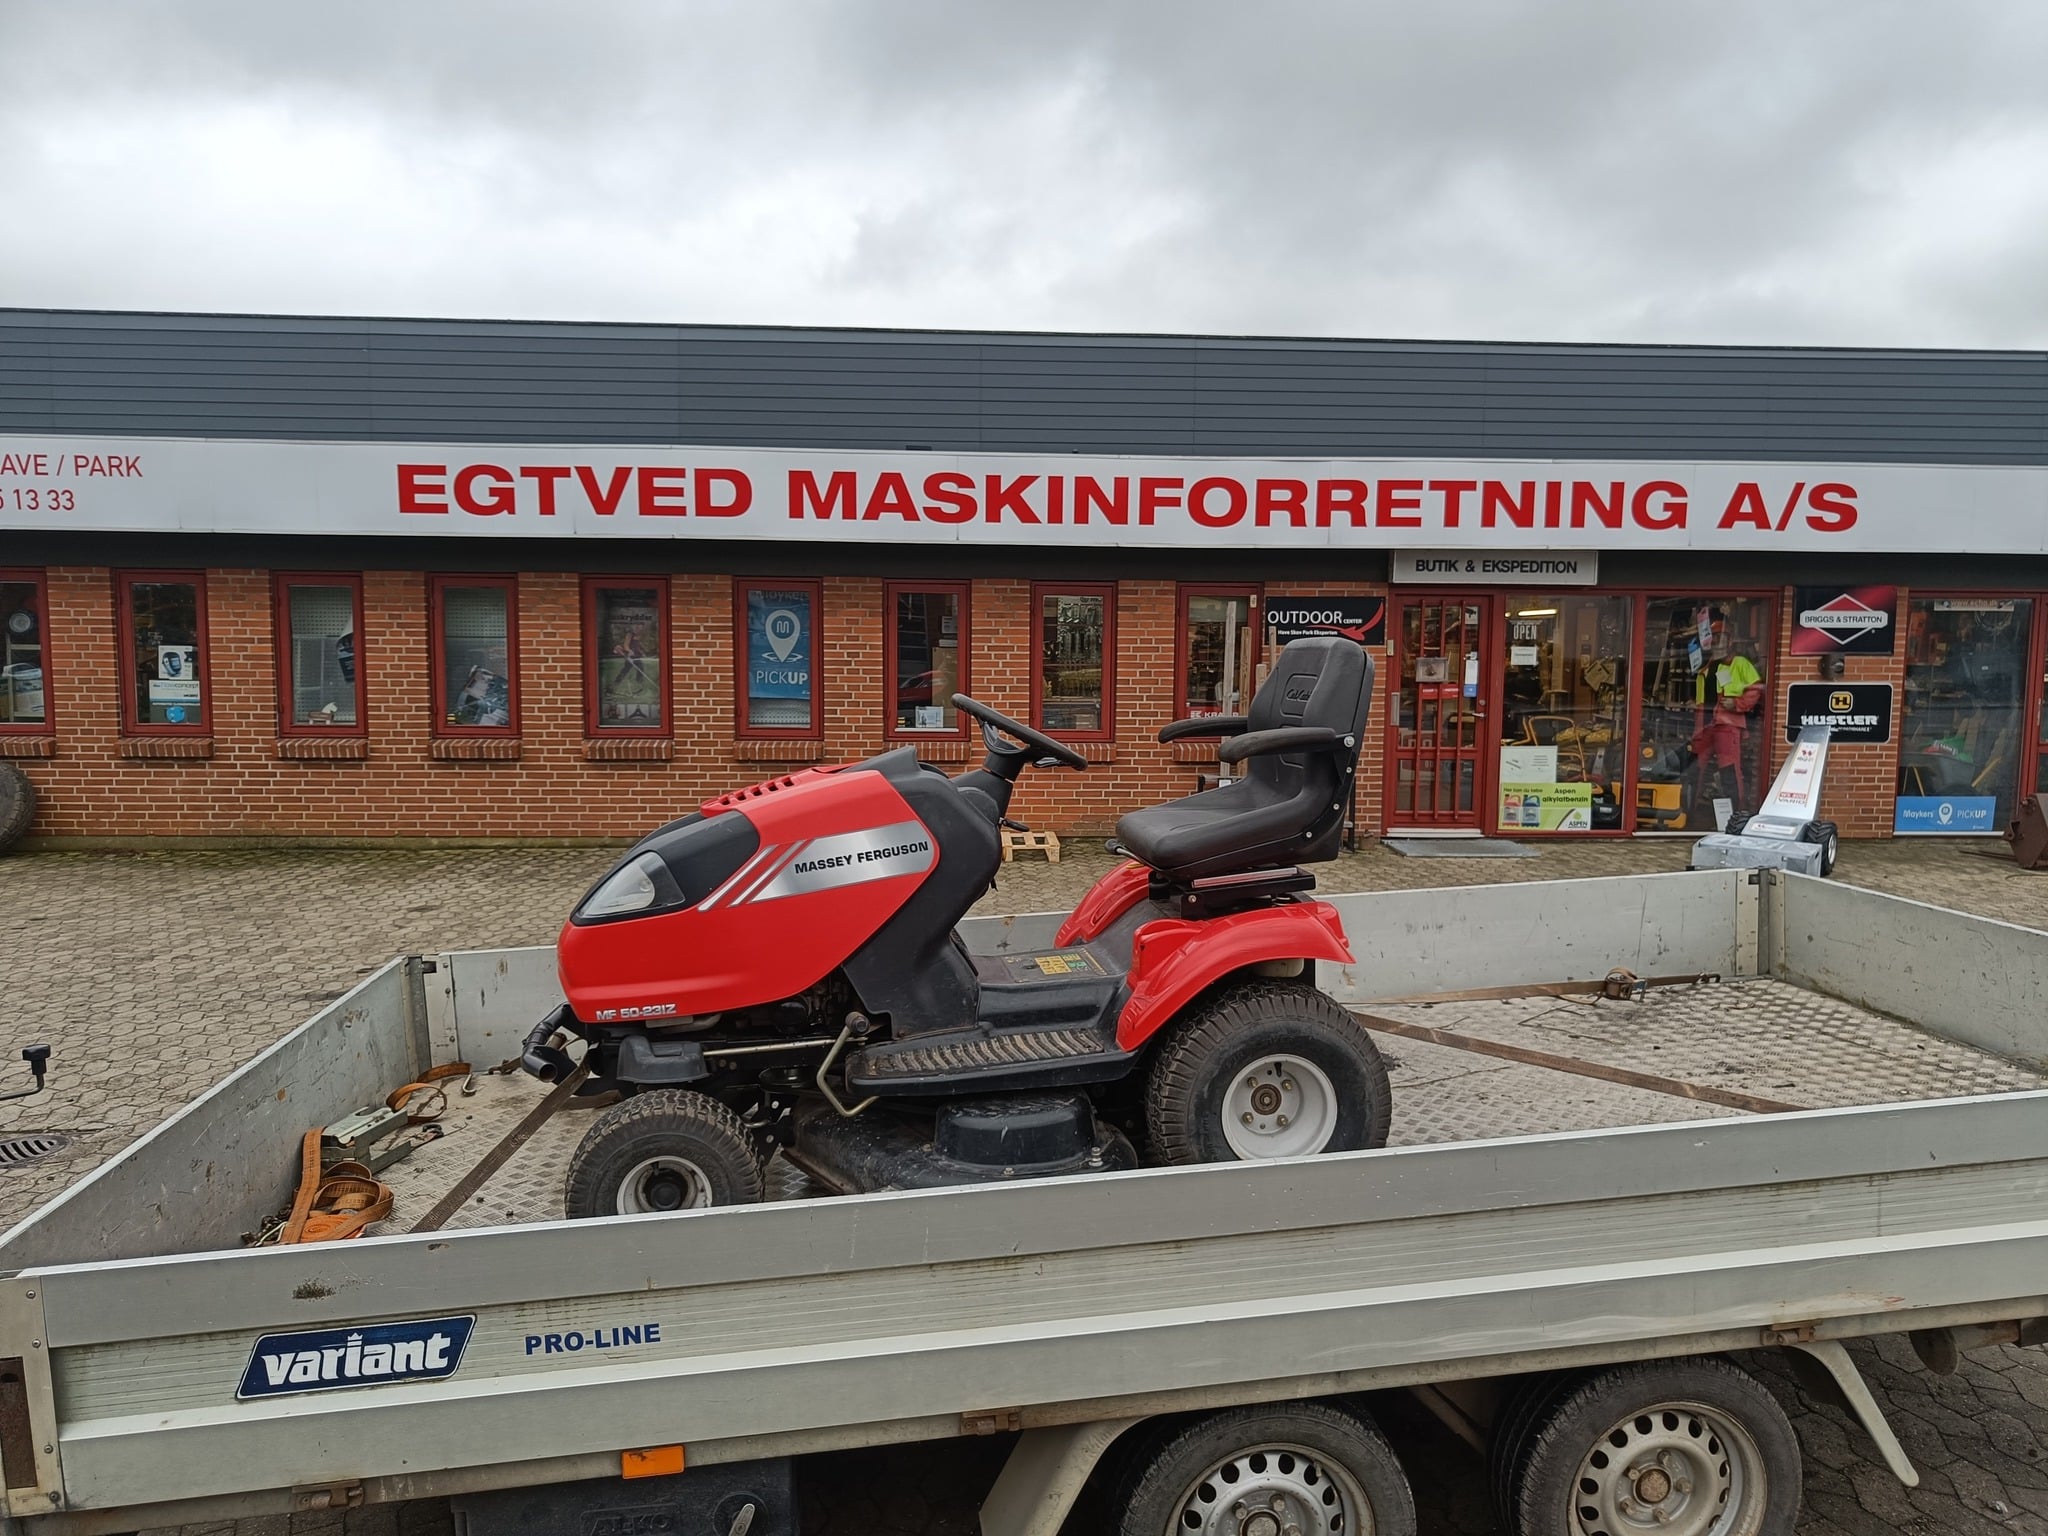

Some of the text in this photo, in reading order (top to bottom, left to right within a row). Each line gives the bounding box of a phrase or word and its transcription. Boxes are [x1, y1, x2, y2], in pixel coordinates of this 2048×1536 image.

[0, 453, 143, 477] AVE / PARK
[13, 488, 40, 511] 13
[46, 489, 75, 511] 33
[397, 464, 1858, 532] EGTVED MASKINFORRETNING A/S
[1415, 559, 1578, 574] BUTIK & EKSPEDITION
[1267, 610, 1343, 624] OUTDOOR
[1804, 615, 1883, 624] BRIGGS & STRATTON
[1513, 624, 1537, 640] OPEN
[756, 670, 809, 685] PICKUP
[1800, 715, 1878, 725] HUSTLER
[1554, 787, 1576, 795] Aspen
[1542, 795, 1589, 803] alkylatbenzin
[1902, 809, 1987, 819] Maykers PICKUP
[794, 841, 929, 874] MASSEY FERGUSON
[595, 1009, 617, 1020] MF
[525, 1322, 660, 1355] PRO-LINE
[260, 1332, 451, 1386] variant
